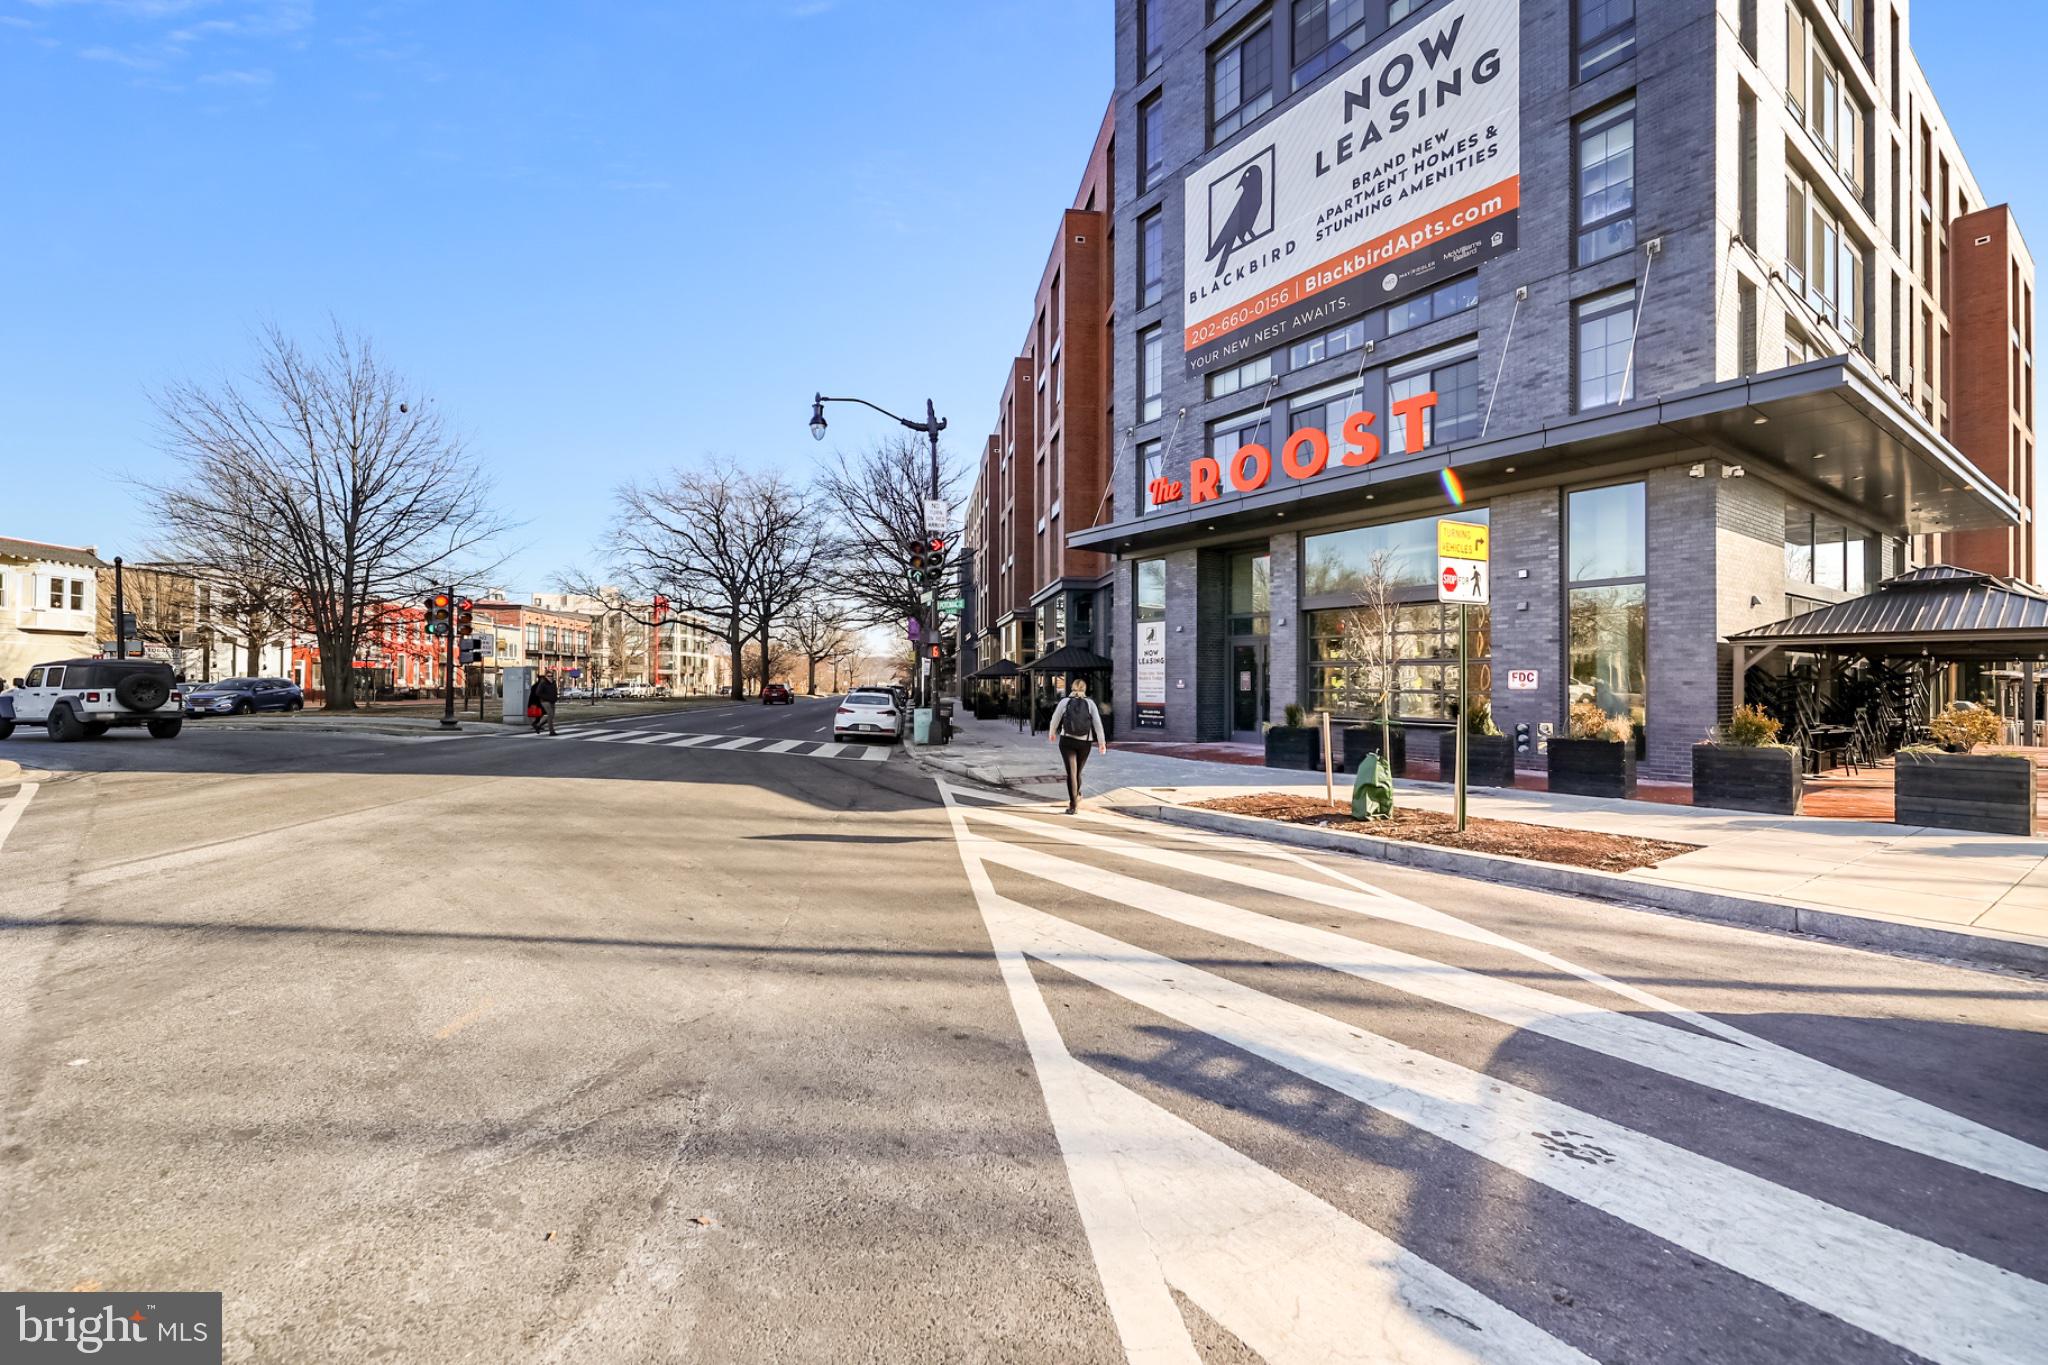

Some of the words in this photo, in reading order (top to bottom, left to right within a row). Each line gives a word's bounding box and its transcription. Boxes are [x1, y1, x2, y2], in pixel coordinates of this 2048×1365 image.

[1344, 14, 1465, 124] NOW
[1315, 48, 1501, 178] LEASING
[1315, 194, 1392, 242] STUNNING
[1398, 143, 1498, 201] AMENITIES
[1316, 168, 1408, 226] APARTMENT
[1414, 133, 1478, 175] HOMES
[1485, 125, 1498, 140] &
[1352, 153, 1406, 190] BRAND
[1411, 128, 1449, 158] NEW
[1189, 240, 1296, 304] BLACKBIRD
[1191, 288, 1289, 345] 202-660-0156
[1305, 195, 1502, 293] BlackbirdApts.com
[1190, 351, 1219, 370] YOUR
[1223, 336, 1250, 356] NEW
[1254, 321, 1287, 344] NEST
[1291, 297, 1351, 329] AWAITS.
[1148, 476, 1184, 505] The
[1190, 391, 1438, 505] ROOST
[1443, 527, 1472, 540] TURNING
[1443, 574, 1457, 585] STOP
[1138, 657, 1165, 665] LEASING
[1143, 649, 1159, 657] NOW
[1511, 671, 1535, 683] FDC
